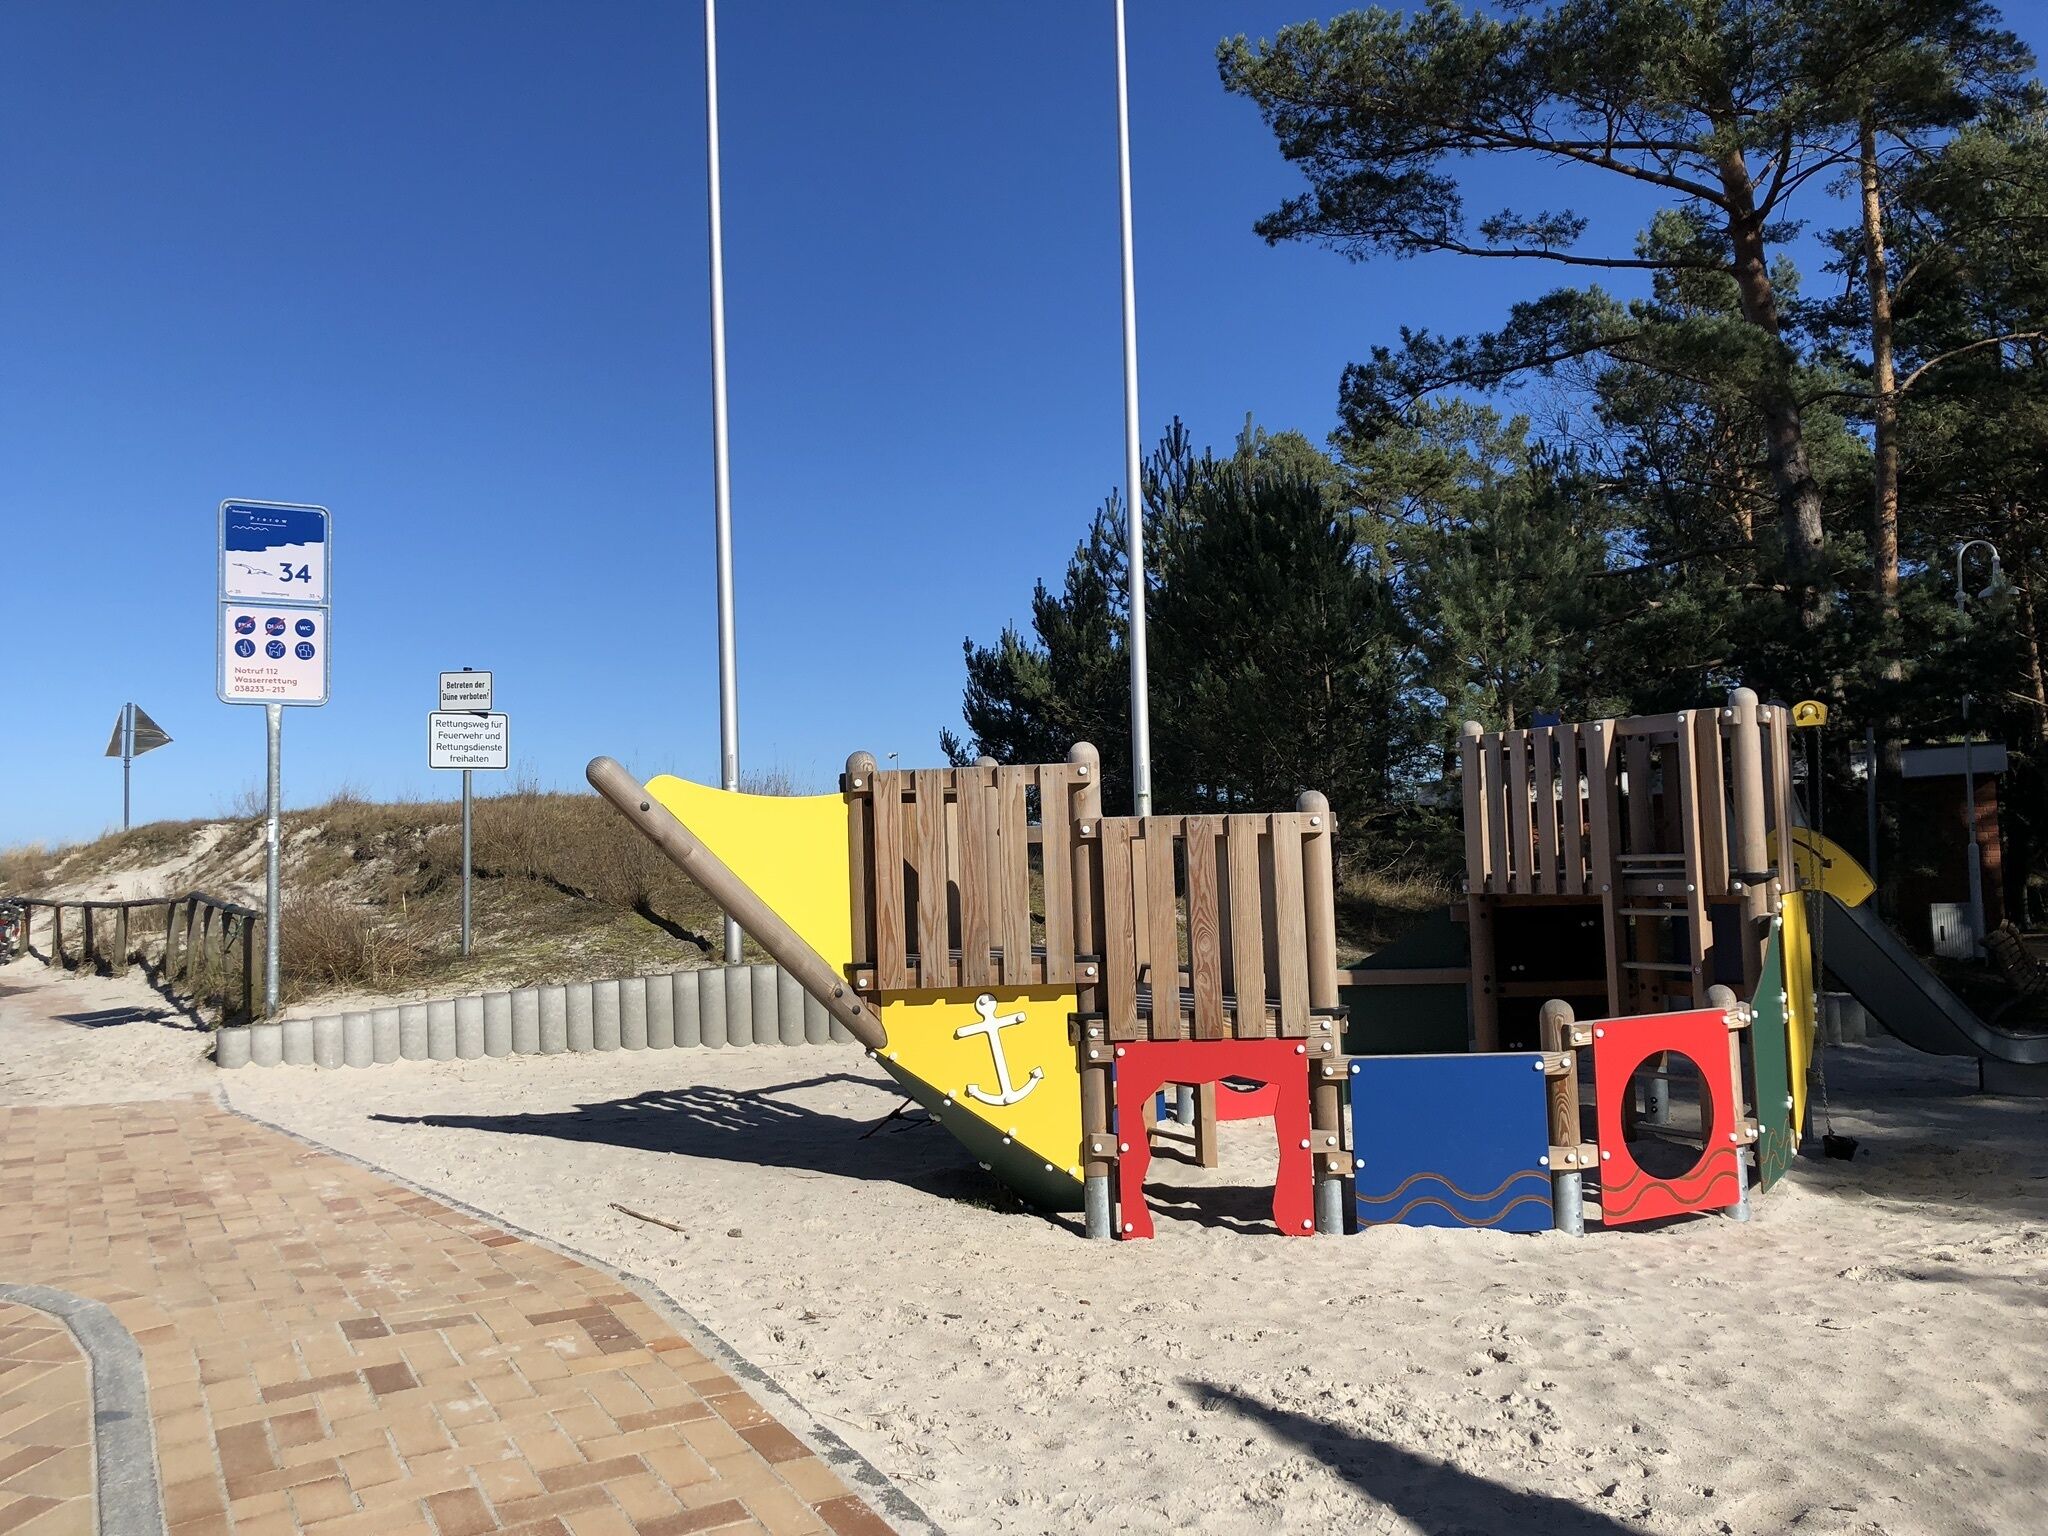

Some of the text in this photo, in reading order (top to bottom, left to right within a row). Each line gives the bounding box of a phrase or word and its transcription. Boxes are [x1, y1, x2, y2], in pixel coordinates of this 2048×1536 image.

[250, 515, 287, 523] Prerow
[279, 562, 312, 583] 34
[235, 676, 297, 686] Wasserrettung
[446, 681, 473, 689] Betreten
[443, 692, 489, 700] Düne verboten!
[435, 719, 489, 730] Rettungsweg
[438, 731, 483, 739] Feuerwehr
[436, 743, 503, 752] Rettungsdienste
[450, 754, 489, 762] freihalten
